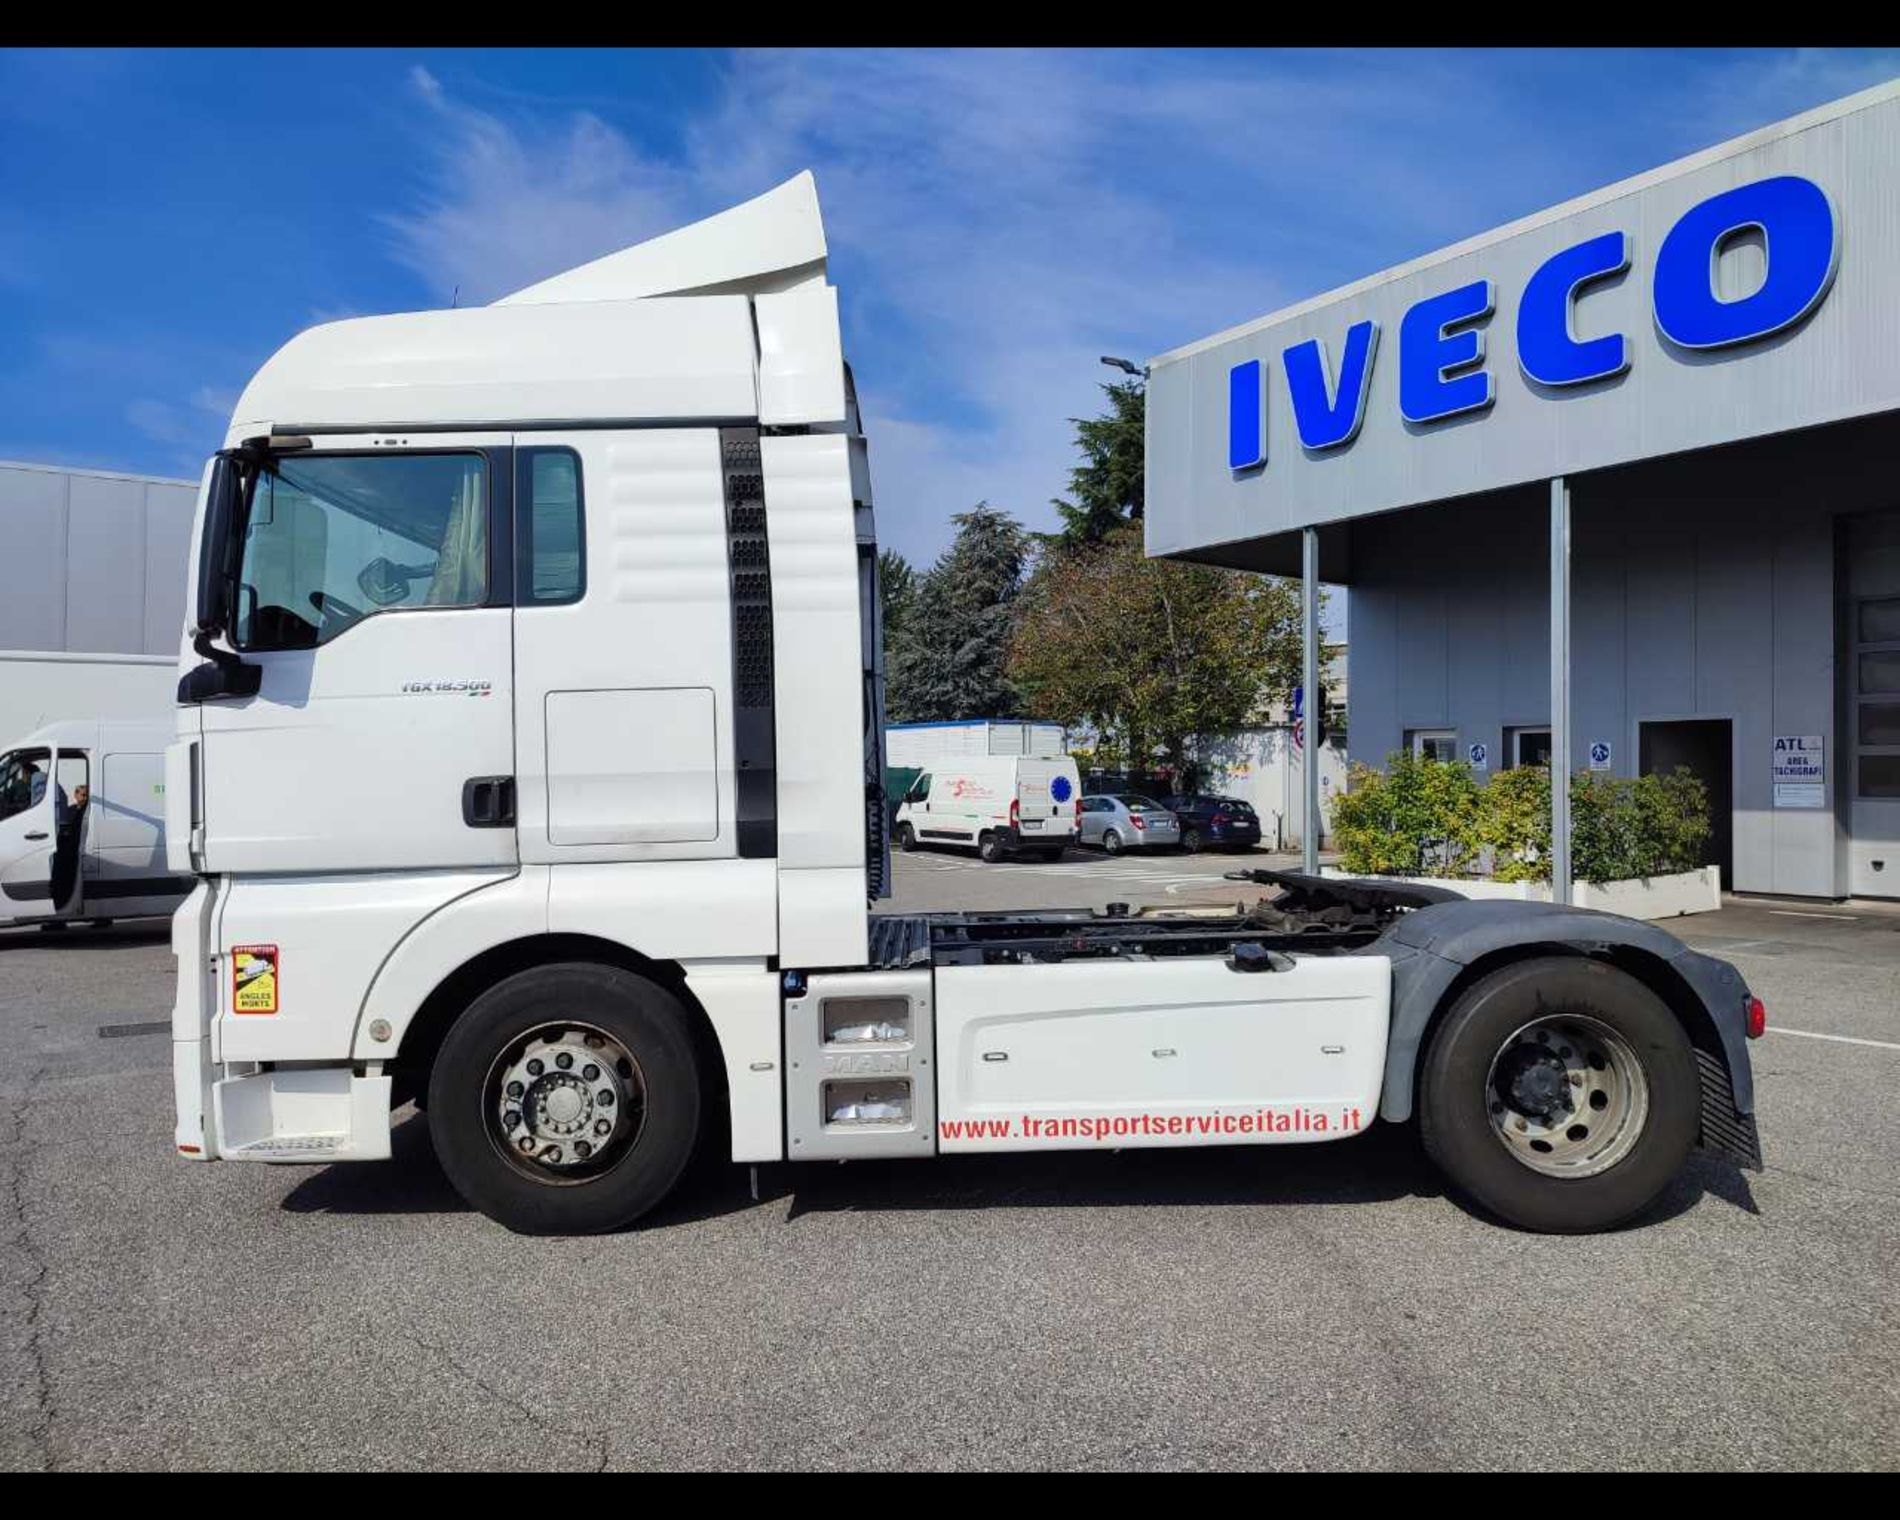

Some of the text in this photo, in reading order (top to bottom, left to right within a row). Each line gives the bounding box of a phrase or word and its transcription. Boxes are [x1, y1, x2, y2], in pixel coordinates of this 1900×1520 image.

[1229, 175, 1839, 470] IVECO
[1775, 738, 1806, 751] ATL
[240, 992, 271, 1000] ANGLES
[241, 1000, 270, 1008] MORTS
[941, 1108, 1361, 1141] www.transportserviceitalia.it
